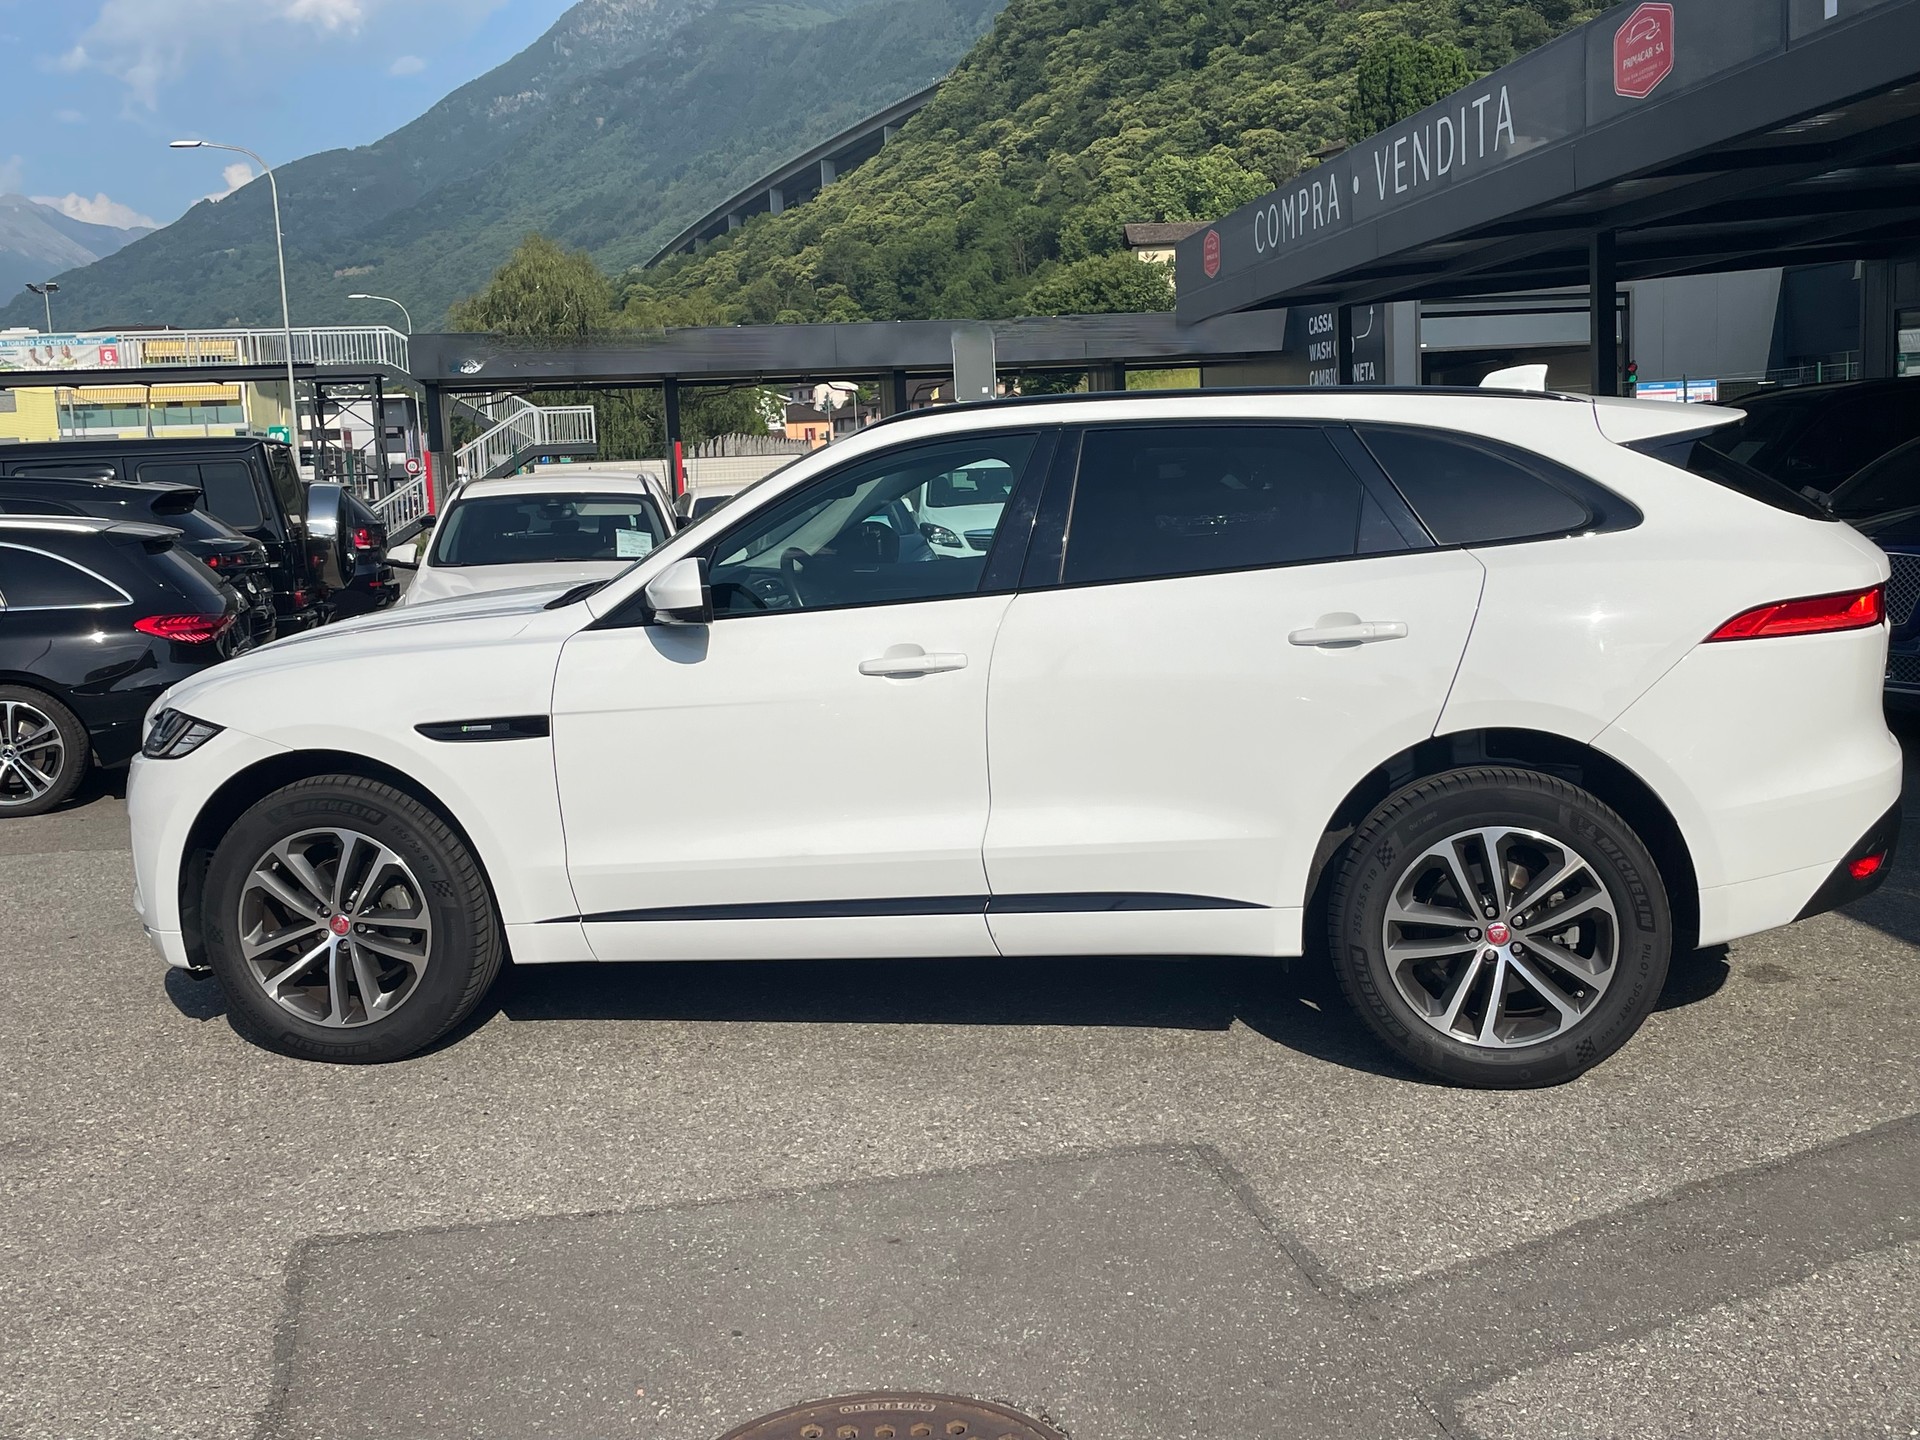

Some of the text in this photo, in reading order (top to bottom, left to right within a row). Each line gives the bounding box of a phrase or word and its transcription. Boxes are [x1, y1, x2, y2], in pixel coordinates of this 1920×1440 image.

[1623, 42, 1665, 70] PRIMACAR SA
[1254, 85, 1516, 253] COMPRA VENDITA
[1308, 313, 1333, 335] CASSA
[104, 351, 113, 361] 6
[1309, 341, 1332, 361] WASH
[1353, 362, 1376, 382] NETA
[293, 800, 383, 825] MICHELIN
[1597, 837, 1654, 929] MICHELIN
[1353, 868, 1378, 935] 255/55 R 19
[1640, 943, 1652, 979] PILOT
[1620, 982, 1643, 1020] SPORT
